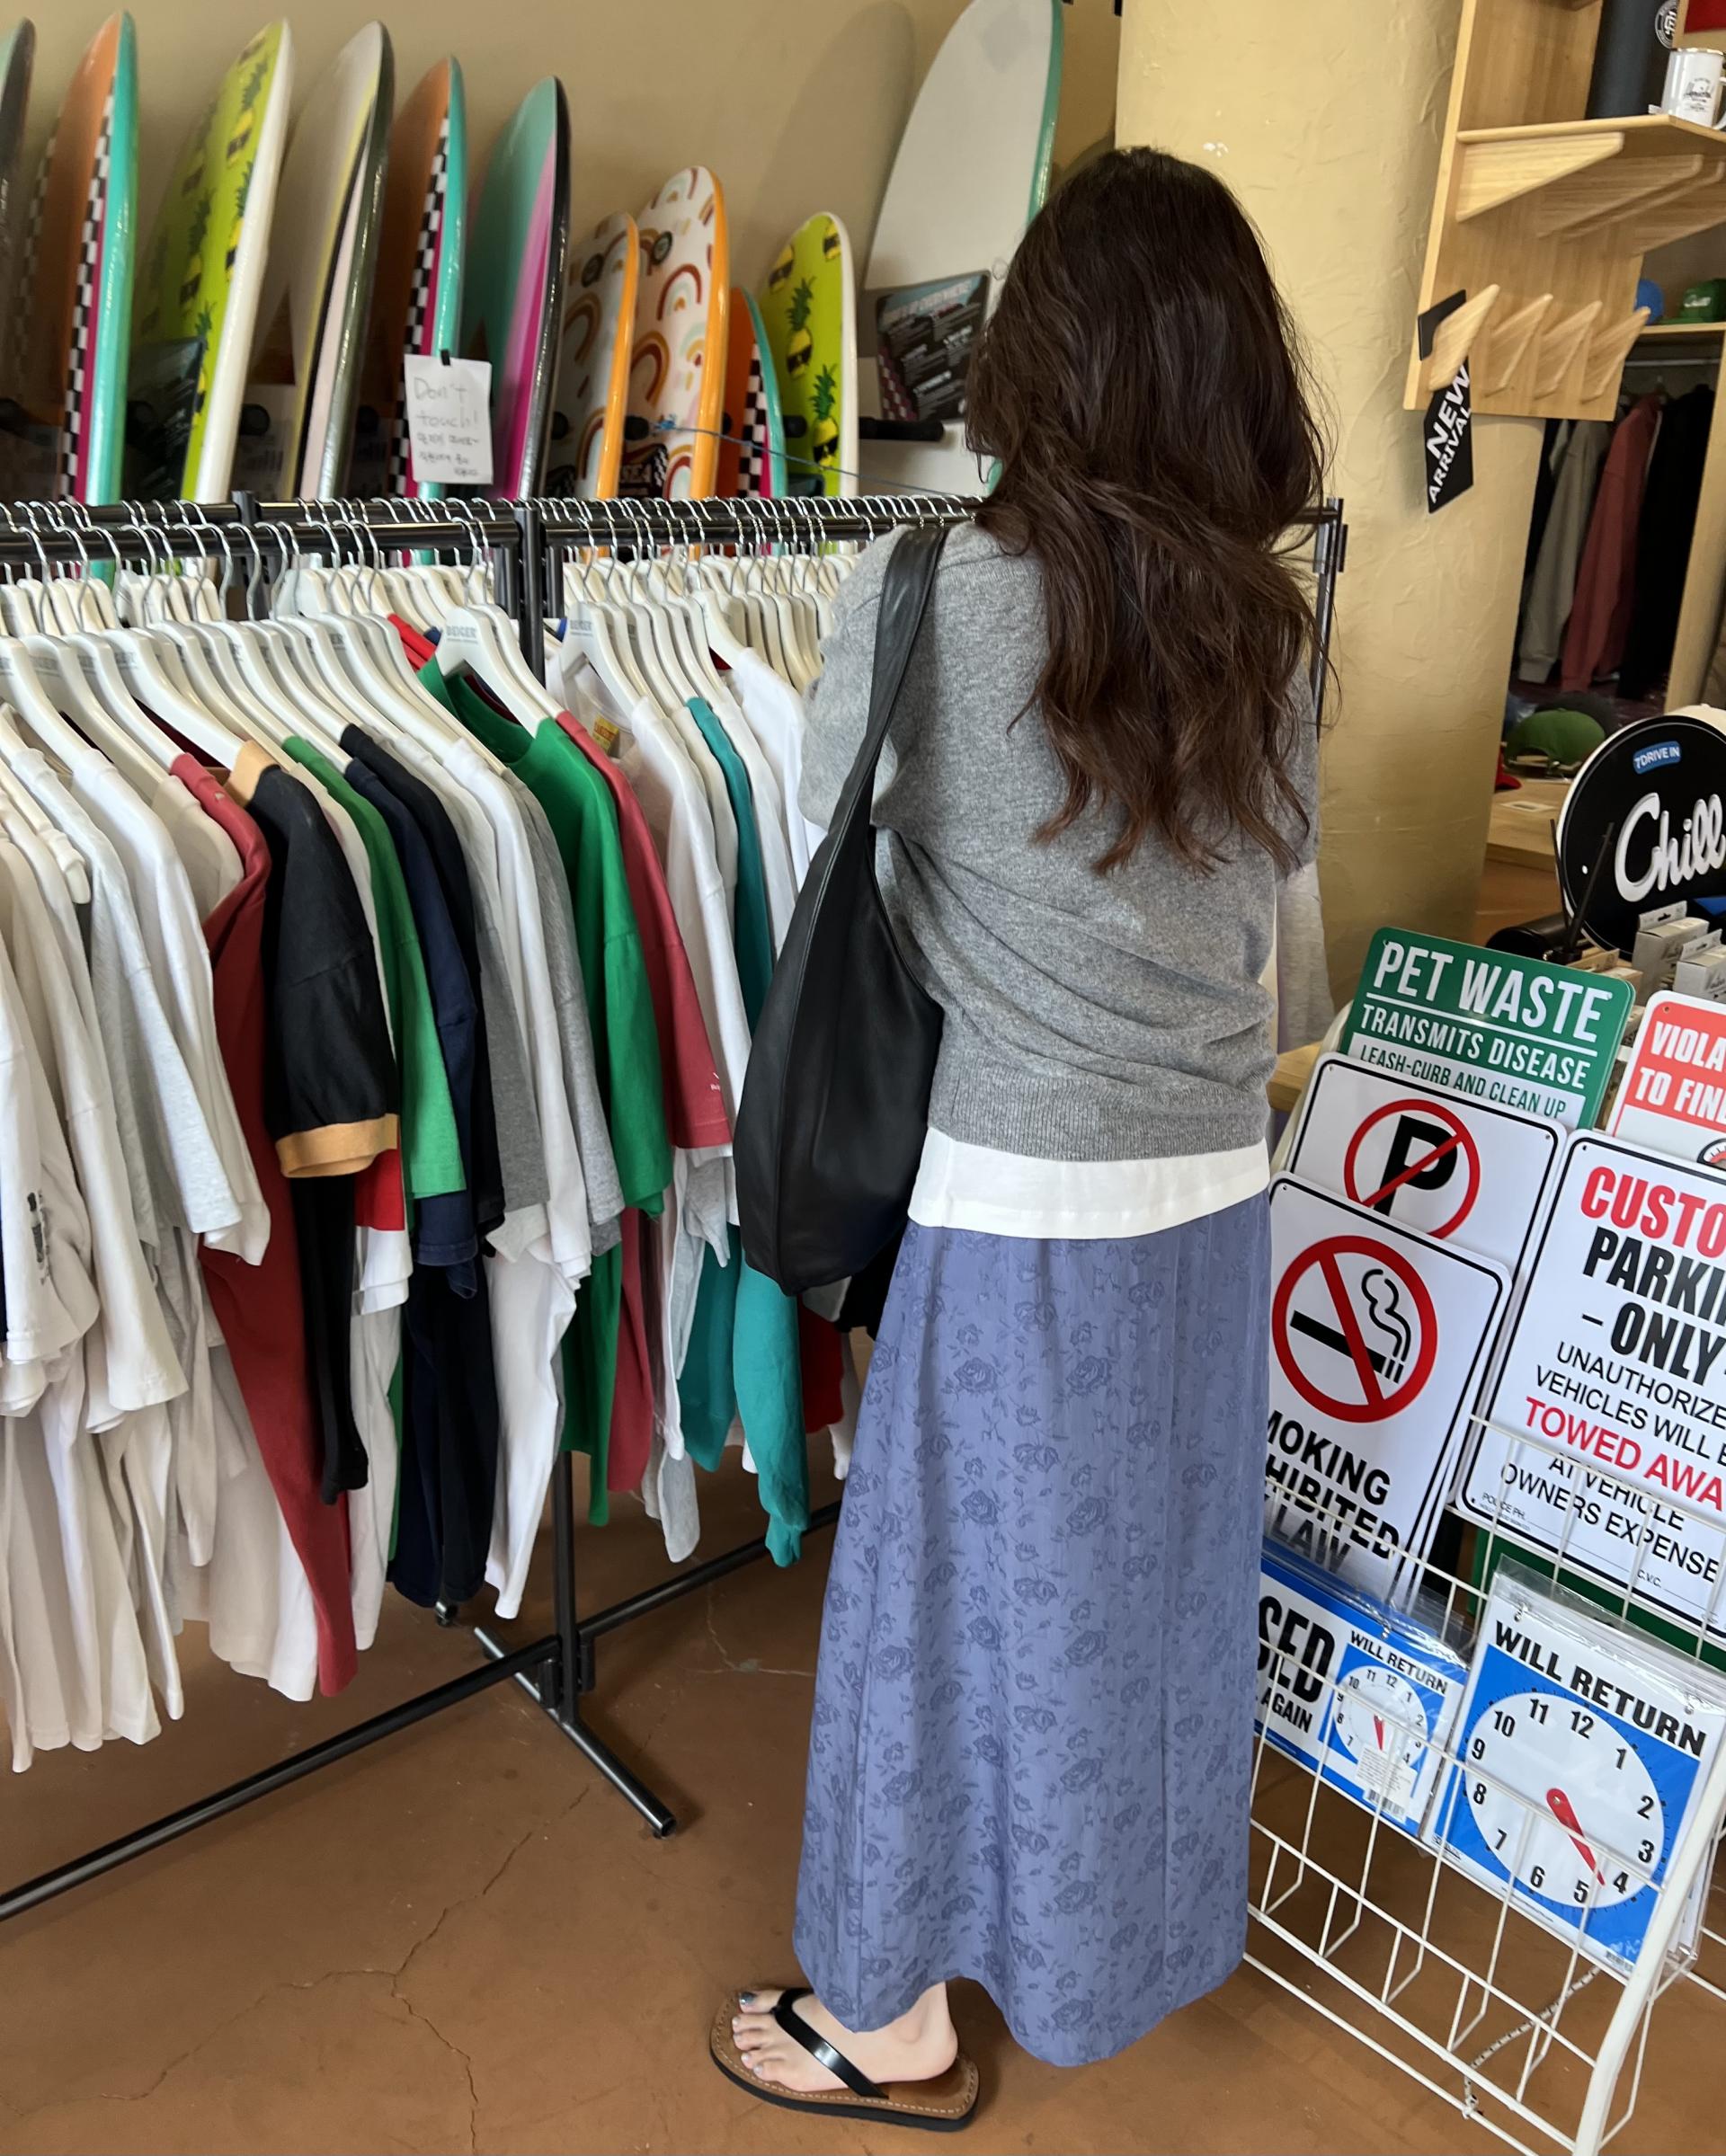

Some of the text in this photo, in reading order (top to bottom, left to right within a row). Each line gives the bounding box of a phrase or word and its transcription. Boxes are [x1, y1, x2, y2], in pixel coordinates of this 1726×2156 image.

[414, 377, 467, 404] Don't
[1427, 364, 1471, 459] NEW
[1615, 794, 1726, 902] Chill
[1374, 941, 1613, 1043] PET WASTE
[1360, 1003, 1591, 1090] TRANSMITS DISEASE
[1360, 1044, 1566, 1119] LEASH-CURB AND CLEAN UP
[1634, 1066, 1673, 1106] TO
[1580, 1166, 1726, 1259] CUSTO
[1582, 1226, 1726, 1327] PARKI
[1610, 1301, 1726, 1386] ONLY
[1557, 1340, 1726, 1431] UNAUTHORIZE
[1536, 1364, 1649, 1431] VEHICLES
[1654, 1414, 1711, 1460] WILL
[1526, 1395, 1724, 1512] TOWED AWA
[1549, 1451, 1580, 1479] AT
[1585, 1466, 1685, 1531] VEHICLE
[1500, 1463, 1602, 1525] OWNERS
[1605, 1512, 1719, 1584] EXPENSE
[1350, 1630, 1448, 1694] WILL RETURN
[1366, 1669, 1376, 1682] 11
[1348, 1675, 1360, 1690] 10
[1386, 1674, 1398, 1688] 12
[1496, 1620, 1707, 1757] WILL RETURN
[1261, 1687, 1313, 1734] AGAIN
[1406, 1691, 1412, 1703] 1
[1337, 1713, 1345, 1725] 8
[1416, 1714, 1424, 1726] 2
[1493, 1710, 1516, 1738] 10
[1529, 1698, 1549, 1726] 11
[1570, 1709, 1596, 1739] 12
[1348, 1735, 1354, 1747] 7
[1472, 1737, 1486, 1761] 9
[1616, 1747, 1627, 1770] 1
[1472, 1782, 1488, 1806] 8
[1636, 1796, 1655, 1821] 2
[1495, 1828, 1508, 1850] 7
[1638, 1839, 1655, 1864] 3
[1530, 1866, 1545, 1888] 6
[1613, 1872, 1629, 1894] 4
[1574, 1880, 1590, 1904] 5
